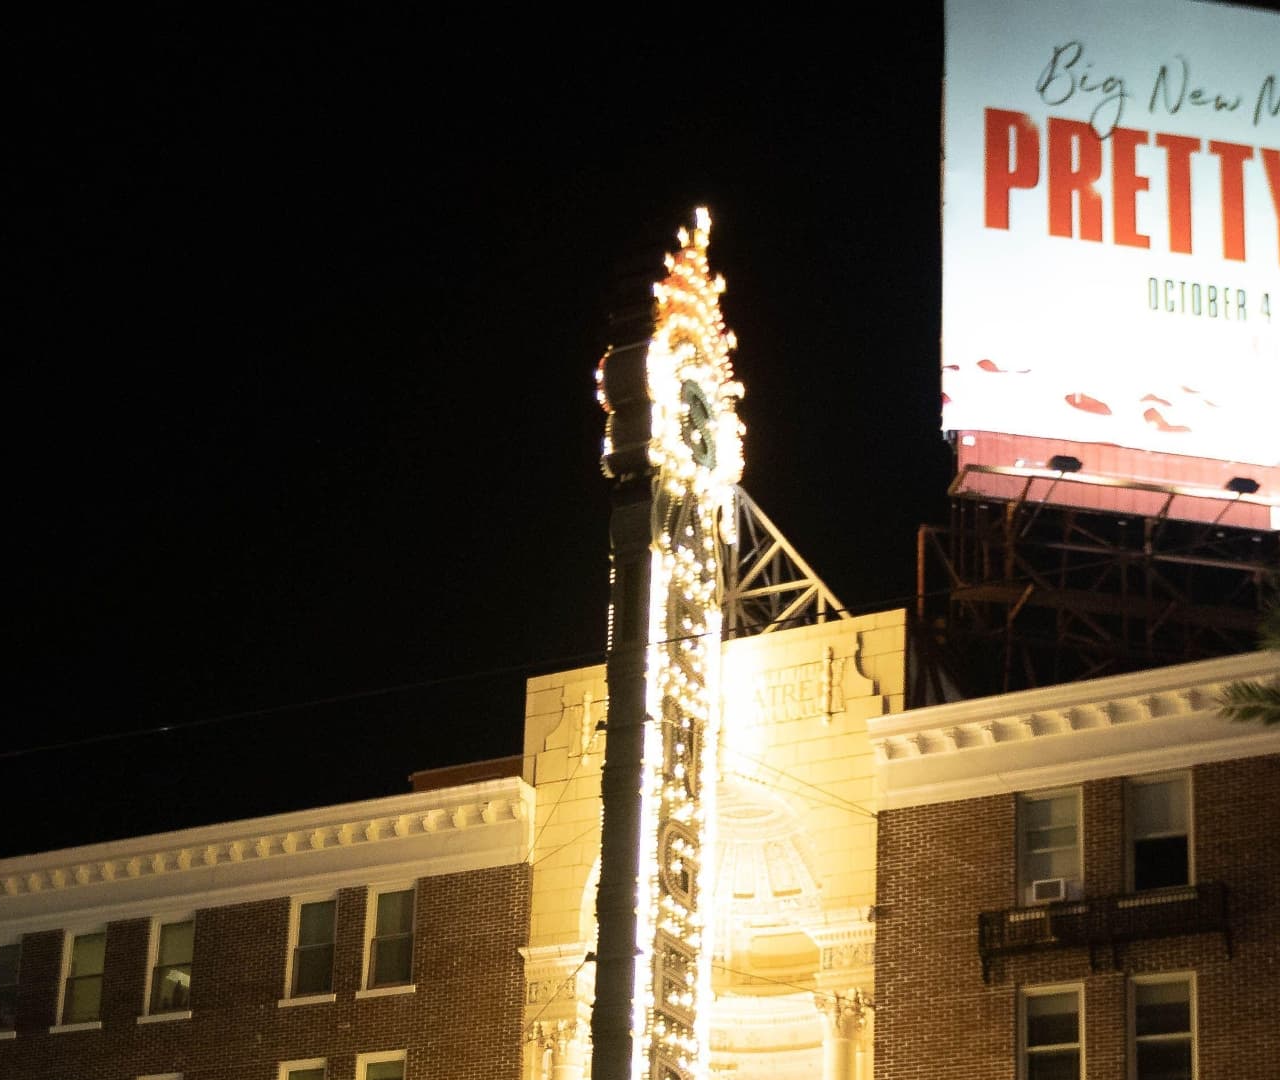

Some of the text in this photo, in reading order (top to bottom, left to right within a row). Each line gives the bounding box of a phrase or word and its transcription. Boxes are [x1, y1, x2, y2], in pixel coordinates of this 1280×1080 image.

[1036, 41, 1132, 140] Big
[1149, 54, 1243, 115] New
[1149, 277, 1247, 321] OCTOBER
[1260, 293, 1272, 323] 4
